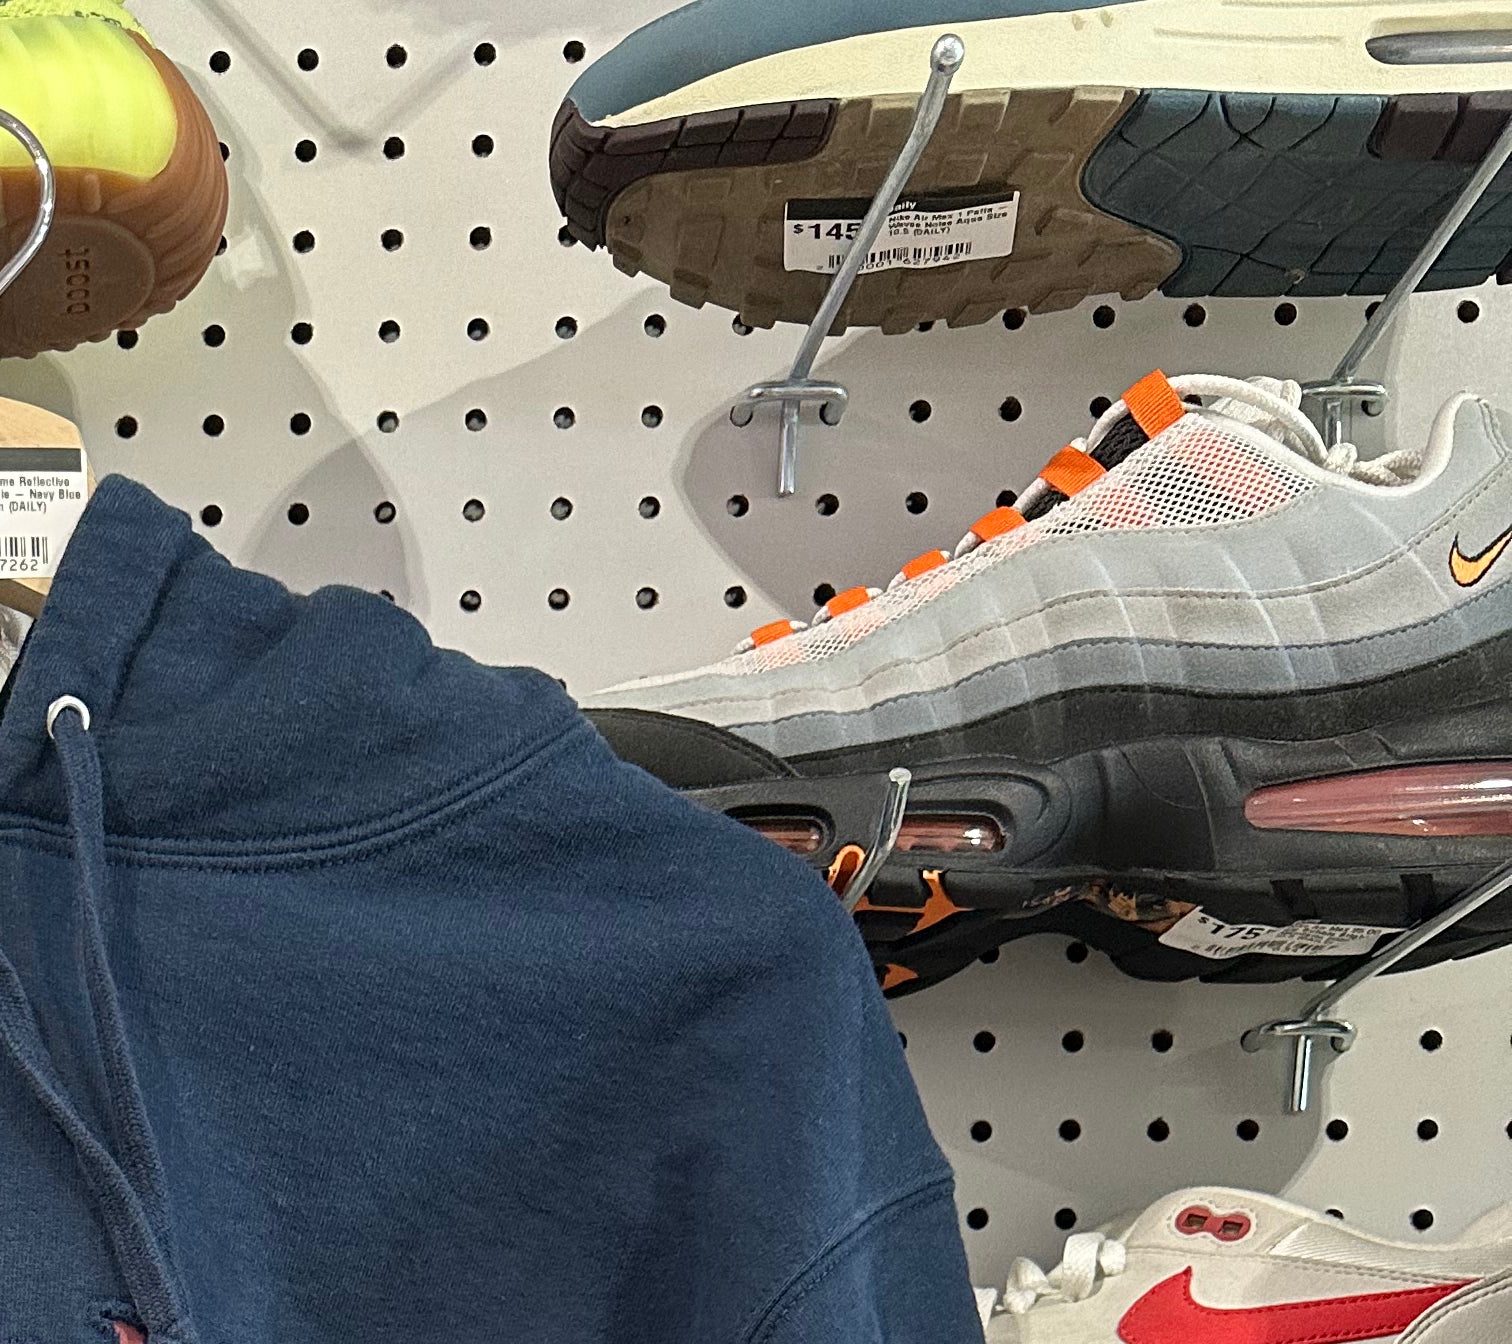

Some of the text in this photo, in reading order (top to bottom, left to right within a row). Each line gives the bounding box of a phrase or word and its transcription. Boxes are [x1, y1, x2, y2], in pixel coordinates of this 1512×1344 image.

[19, 476, 70, 487] Reflective
[29, 489, 54, 501] Navy
[58, 489, 81, 500] Blue
[8, 501, 47, 514] (DAILY)
[1198, 916, 1265, 940] $175
